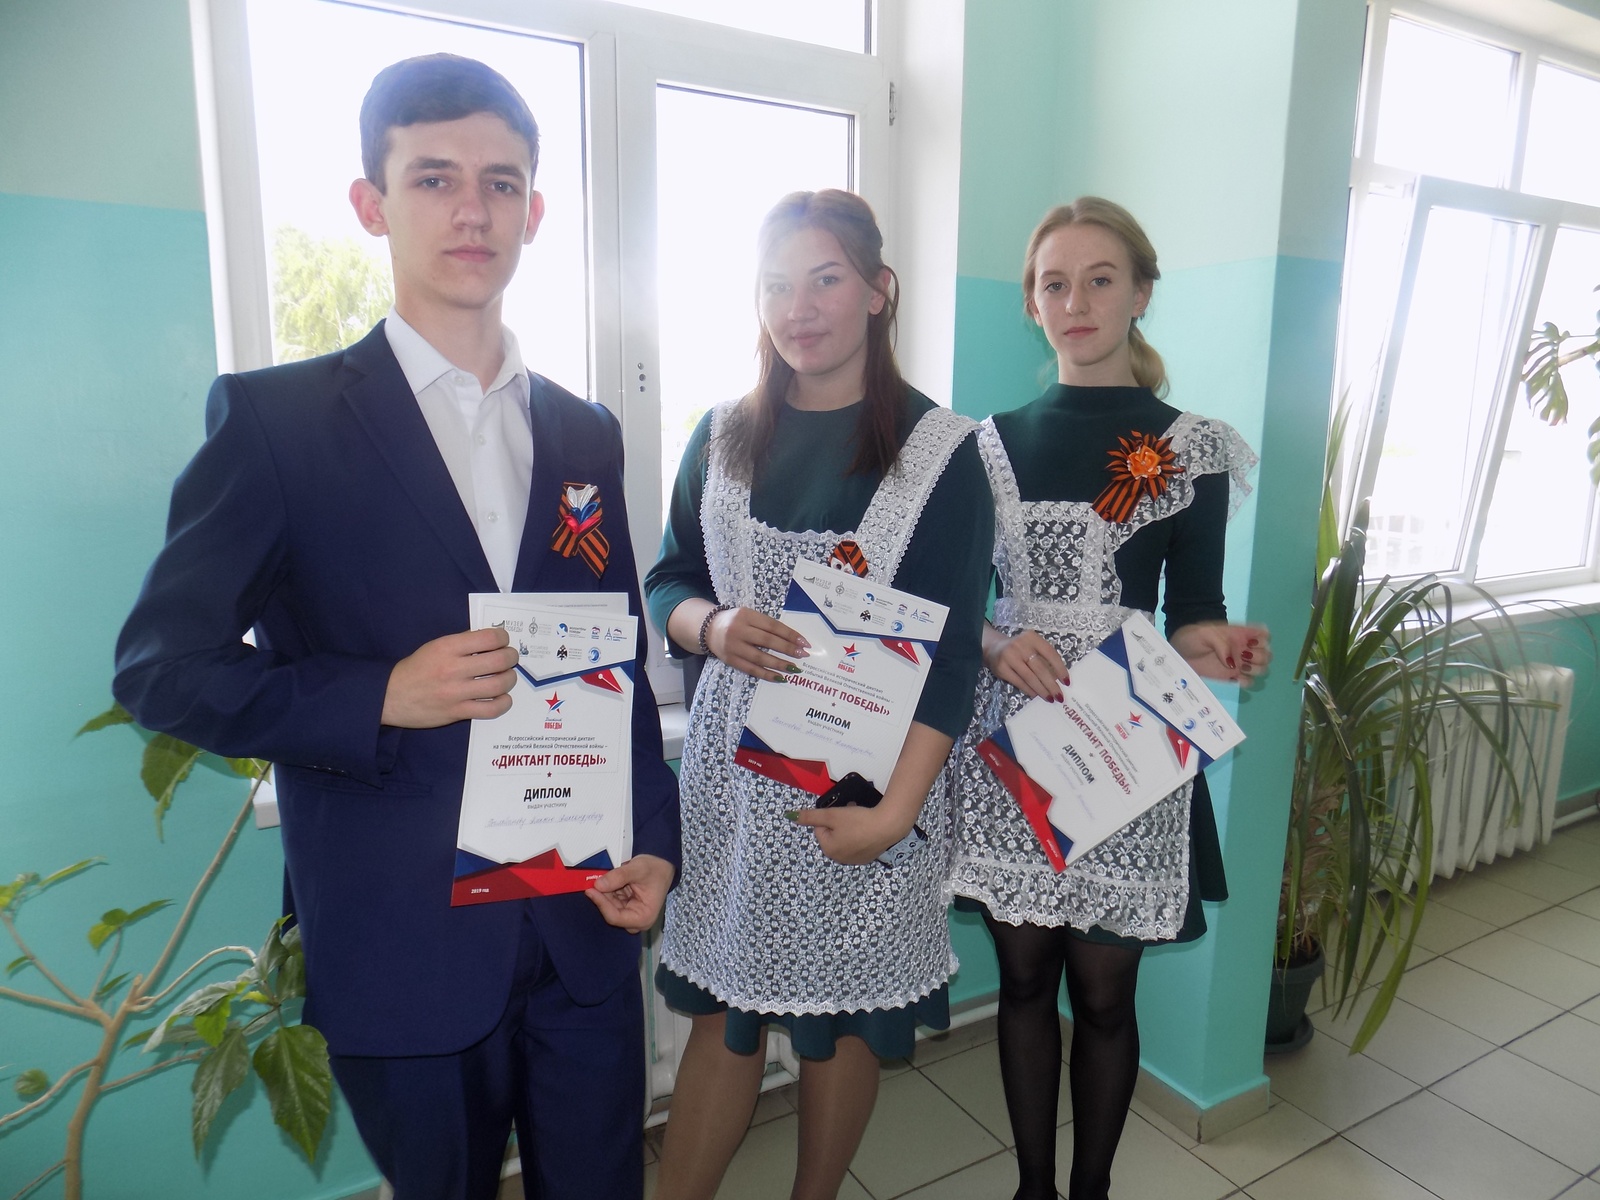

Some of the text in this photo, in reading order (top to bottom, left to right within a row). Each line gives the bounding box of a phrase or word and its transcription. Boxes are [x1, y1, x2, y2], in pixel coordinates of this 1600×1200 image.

[784, 674, 890, 716] «ДИКТАНТ ПОБЕДЫ»
[806, 707, 851, 730] ДИПЛОМ
[1062, 704, 1103, 749] «ДИКТАНТ
[1099, 748, 1131, 795] ПОБЕДЫ»
[492, 754, 606, 769] «ДИКТАНТ ПОБЕДЫ»
[1062, 744, 1095, 784] ДИПЛОМ
[524, 787, 571, 802] ДИПЛОМ
[544, 802, 567, 810] участнику
